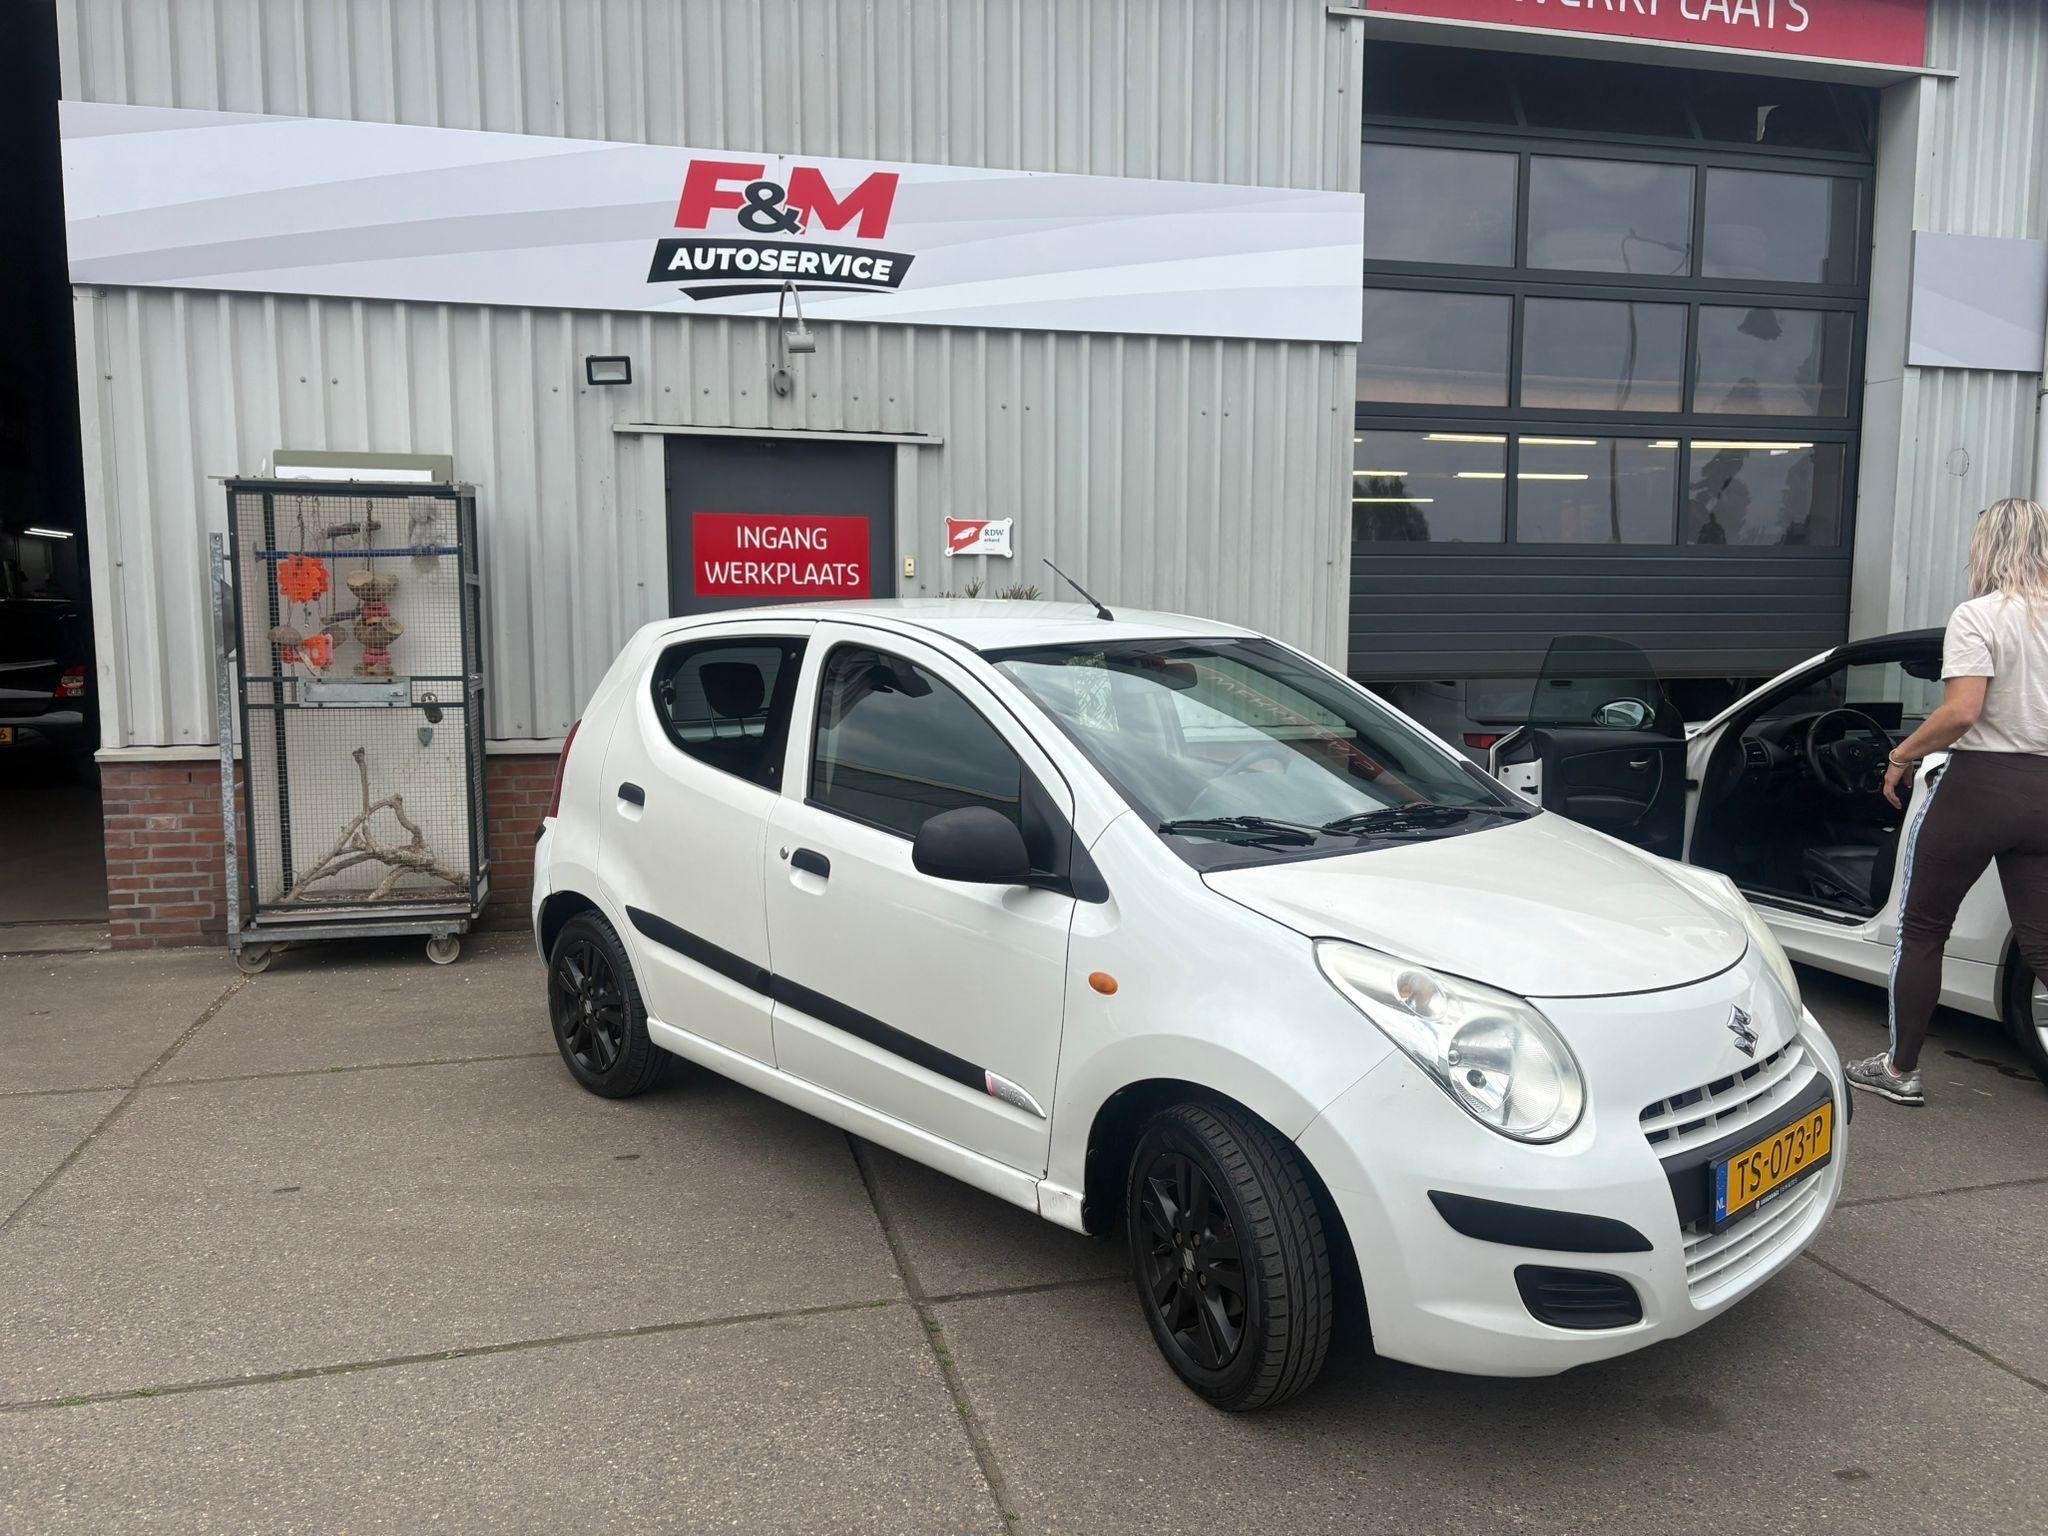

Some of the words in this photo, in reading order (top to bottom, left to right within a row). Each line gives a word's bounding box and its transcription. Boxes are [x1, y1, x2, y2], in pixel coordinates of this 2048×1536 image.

[674, 160, 900, 239] F&M
[668, 248, 893, 281] AUTOSERVICE
[736, 526, 827, 550] INGANG
[704, 560, 860, 586] WERKPLAATS
[1736, 1115, 1823, 1200] TS-073-P
